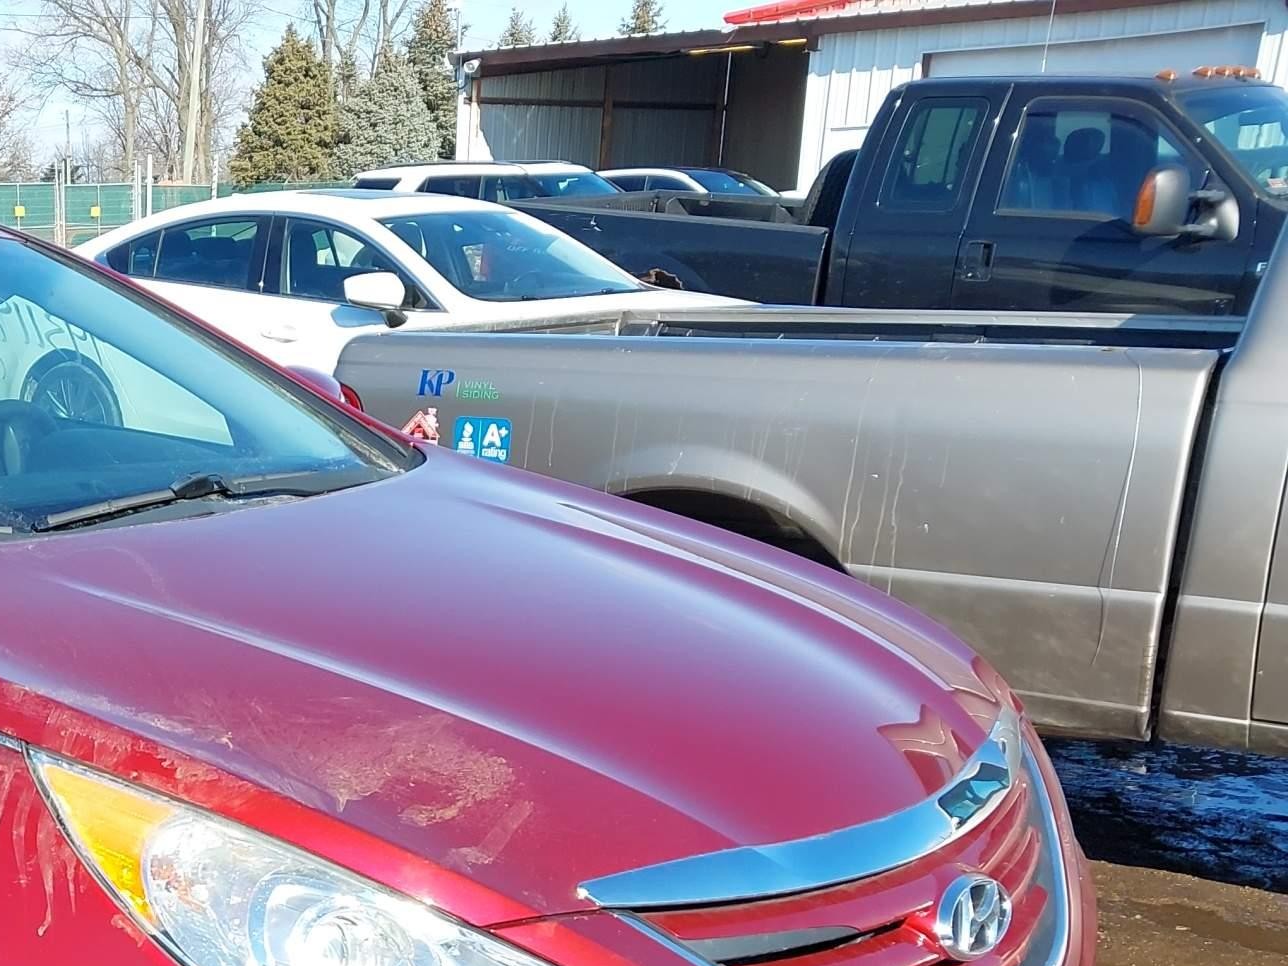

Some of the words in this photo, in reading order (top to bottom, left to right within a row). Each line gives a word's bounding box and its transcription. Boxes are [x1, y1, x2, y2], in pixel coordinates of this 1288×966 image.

[416, 368, 456, 397] KP
[464, 380, 496, 390] VINYL
[462, 390, 499, 400] SIDING
[482, 423, 508, 447] A+
[482, 447, 506, 461] rating
